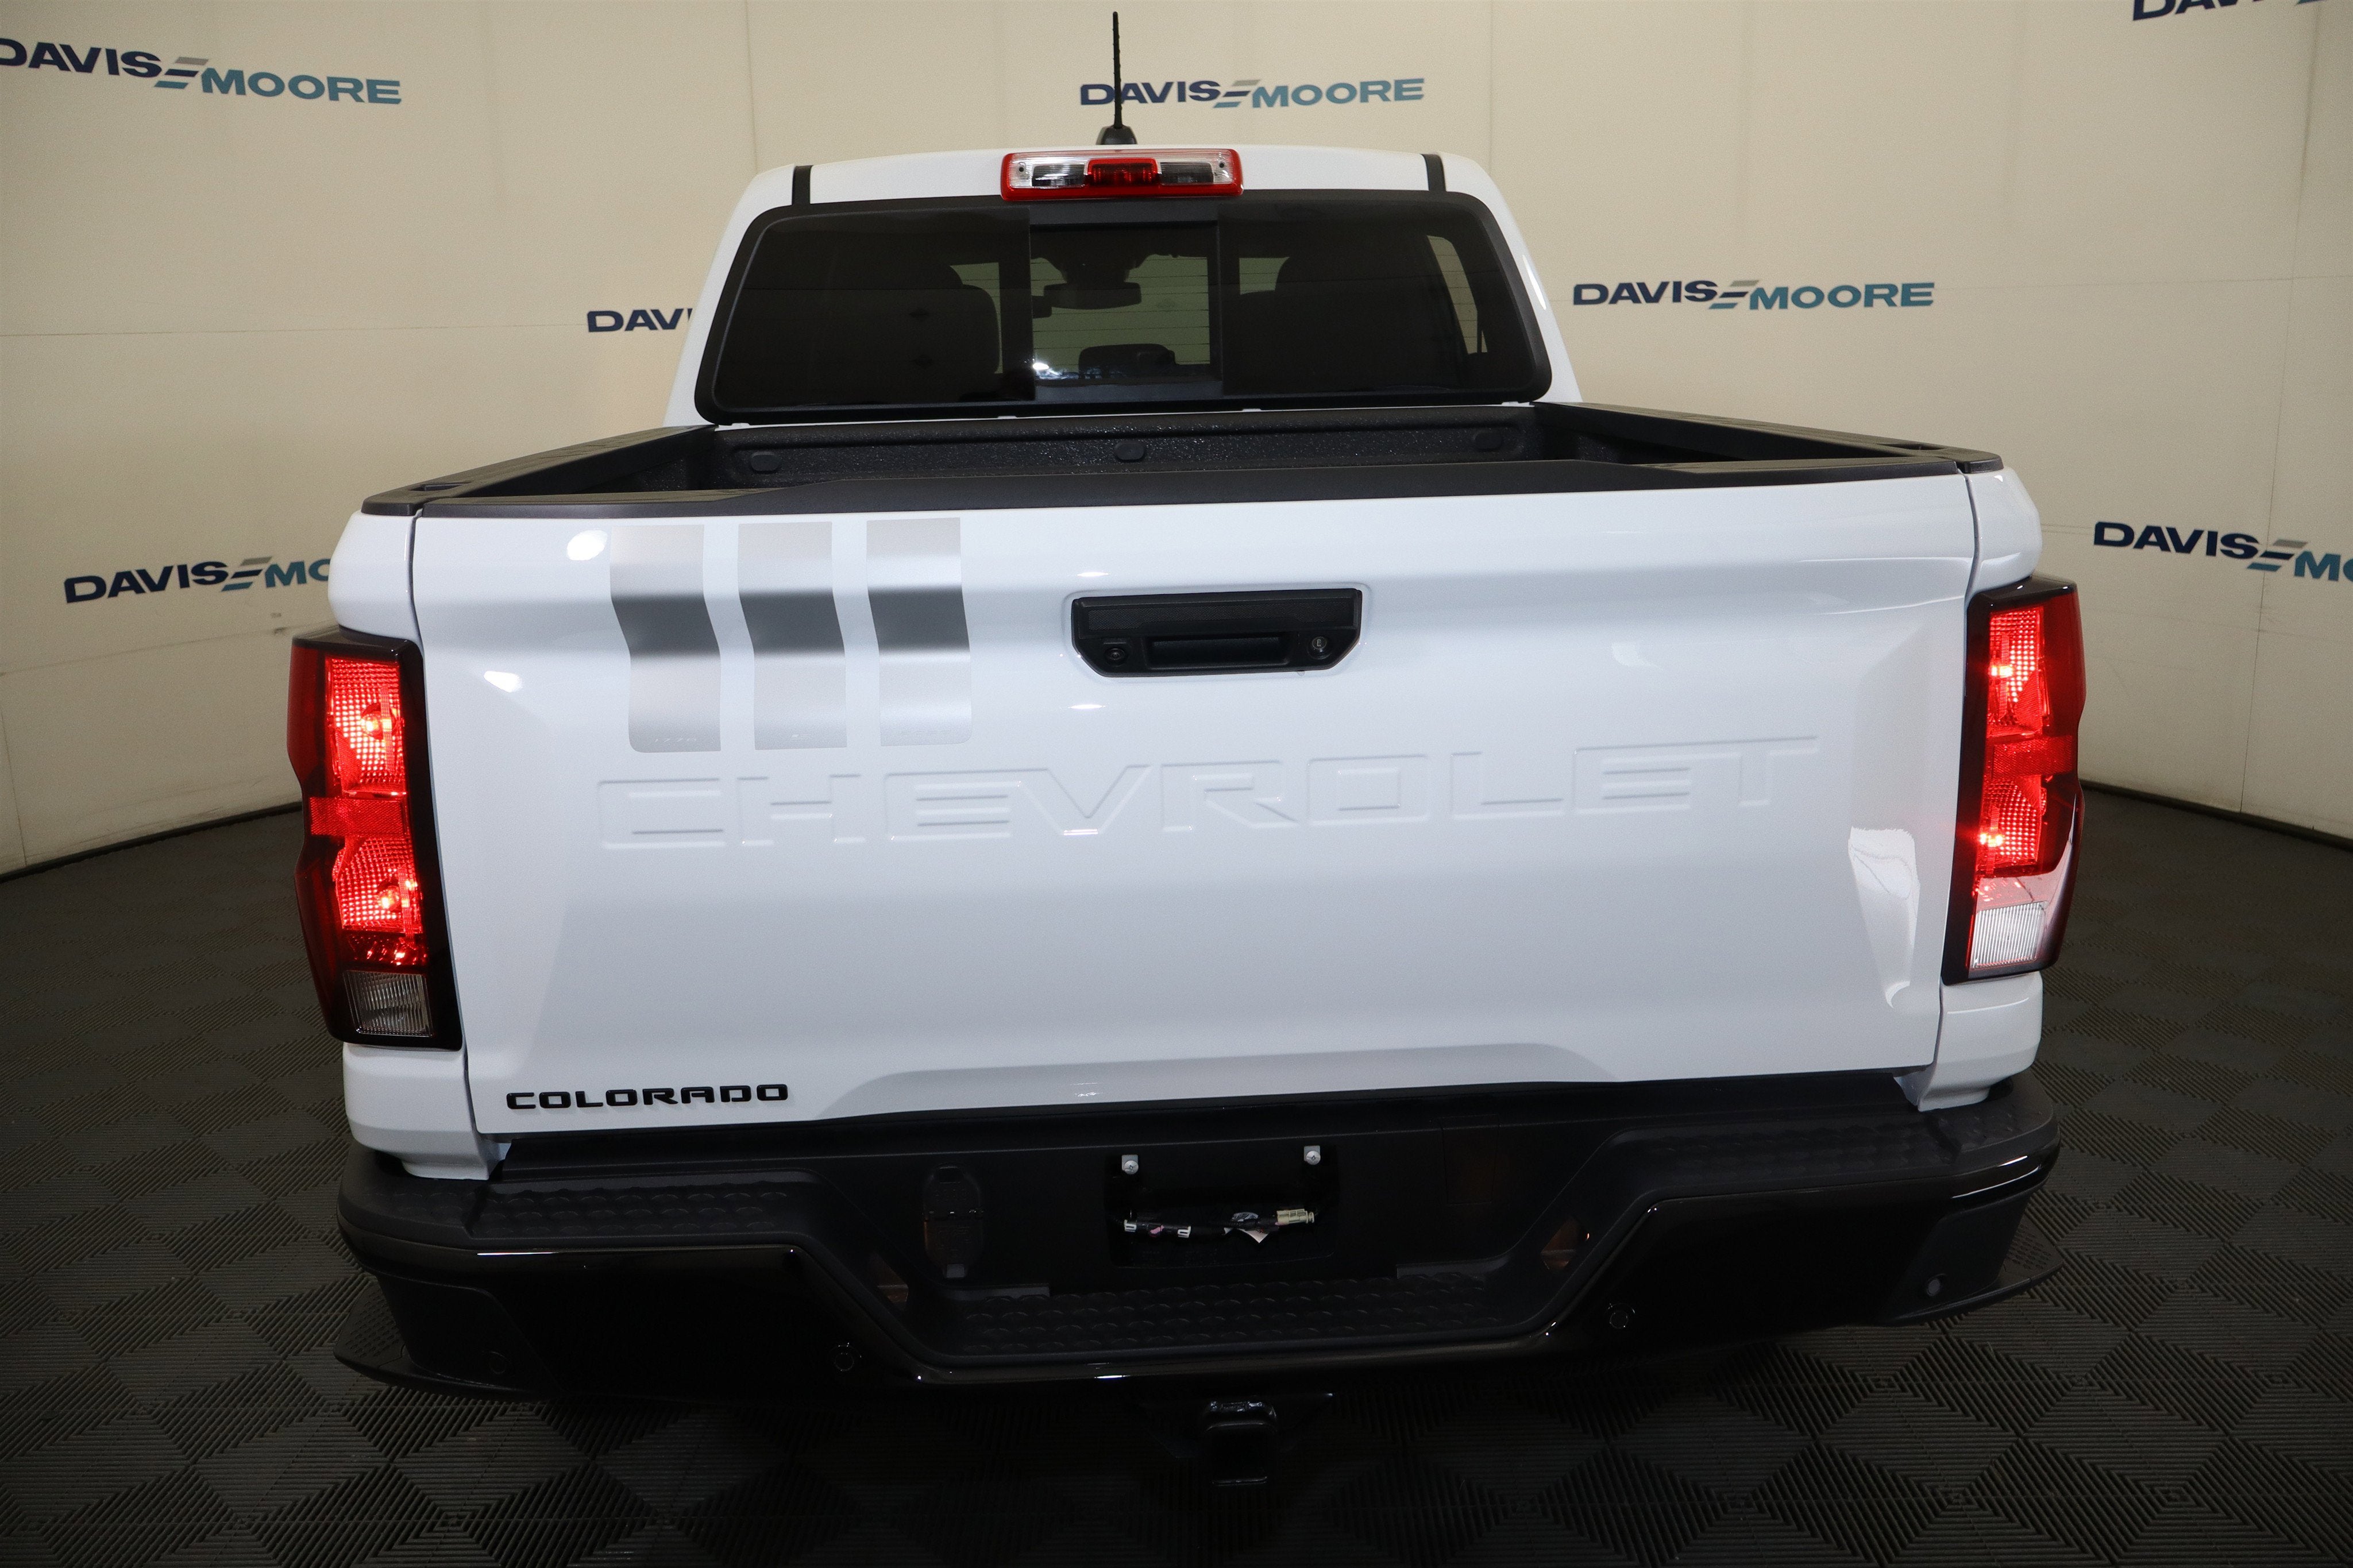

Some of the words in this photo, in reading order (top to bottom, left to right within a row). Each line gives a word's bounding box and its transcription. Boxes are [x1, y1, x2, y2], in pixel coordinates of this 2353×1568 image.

[0, 37, 162, 78] DAVIS
[201, 67, 402, 105] MOORE
[1080, 80, 1221, 105] DAVIS
[1252, 78, 1425, 109] MOORE
[1573, 280, 1718, 306] DAVIS
[1749, 281, 1935, 310] MOORE
[587, 308, 693, 333] DAV
[2093, 521, 2260, 559] DAVIS
[64, 561, 229, 603] DAVIS
[597, 735, 1820, 850] CHEVROLET
[506, 1083, 788, 1110] COLORADO
